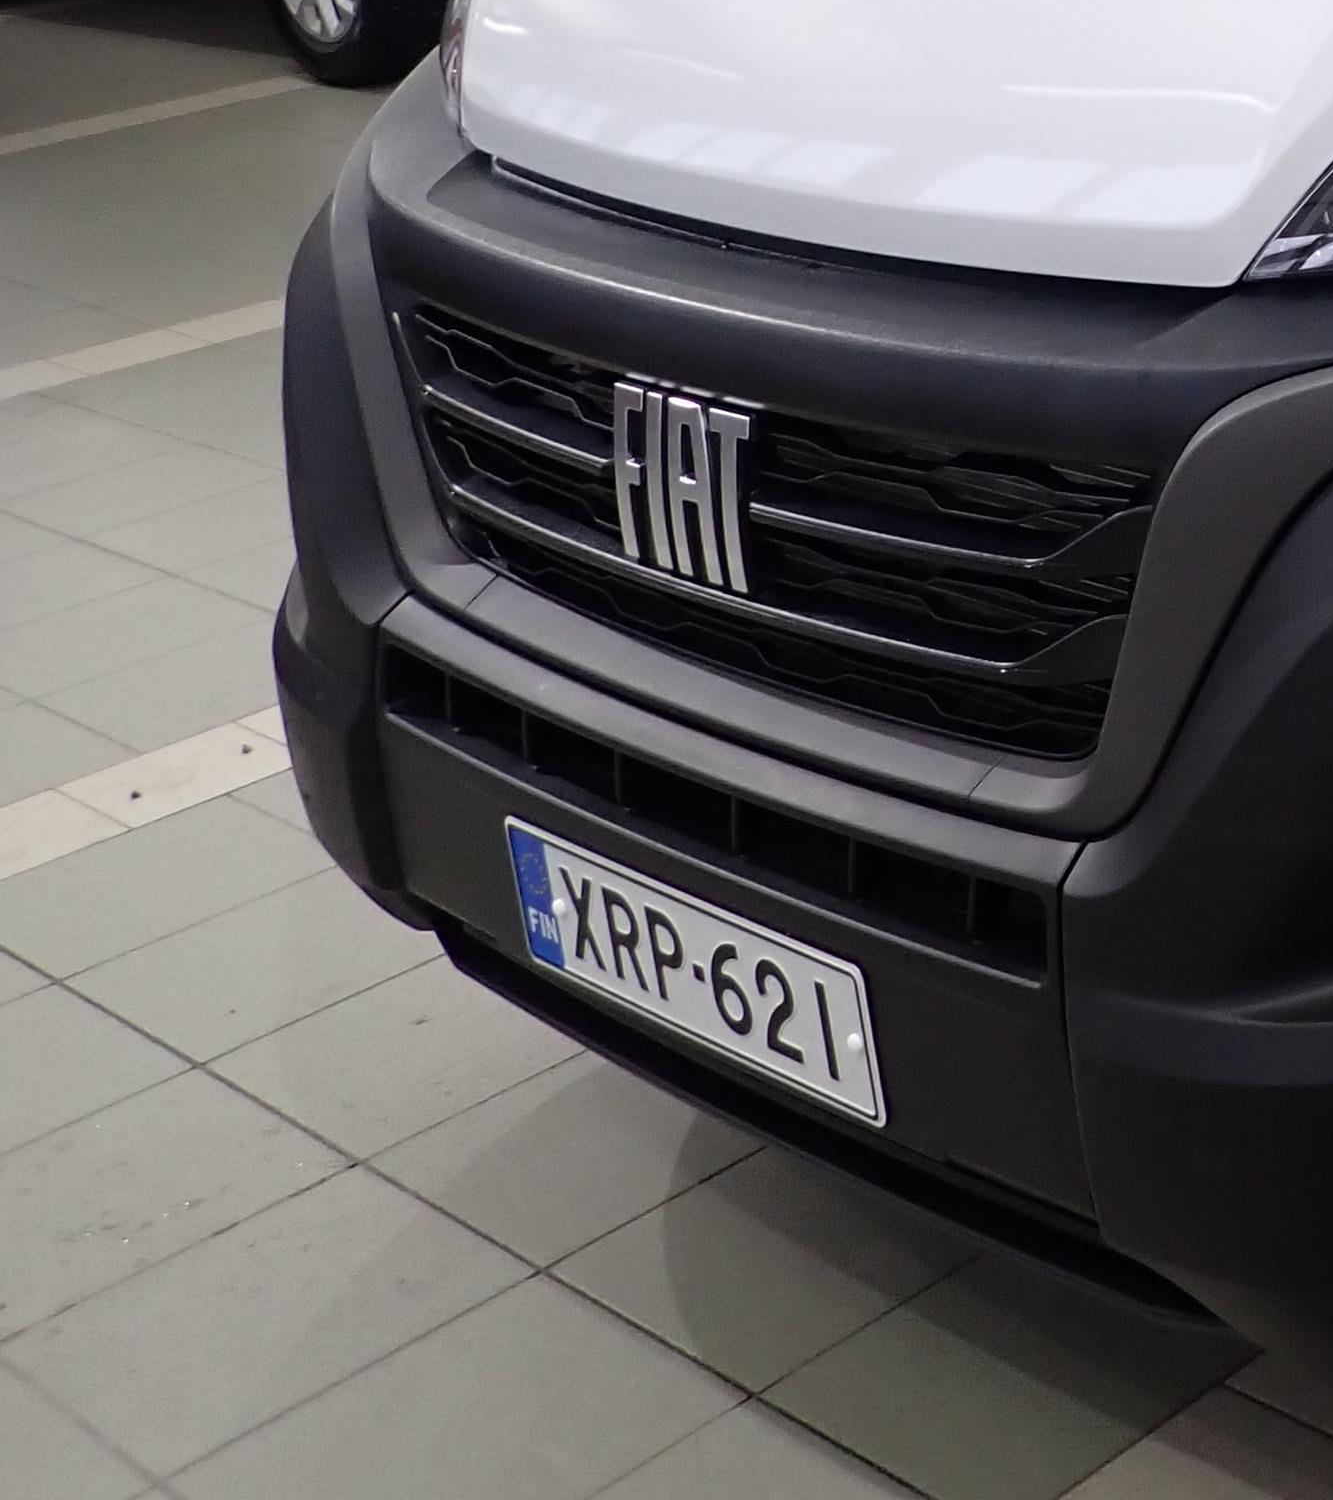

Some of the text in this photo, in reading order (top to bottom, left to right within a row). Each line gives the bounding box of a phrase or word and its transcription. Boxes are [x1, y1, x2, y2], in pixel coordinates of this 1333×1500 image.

[613, 382, 751, 593] FIAT
[528, 905, 560, 944] FIN
[558, 865, 841, 1082] XRP-621
